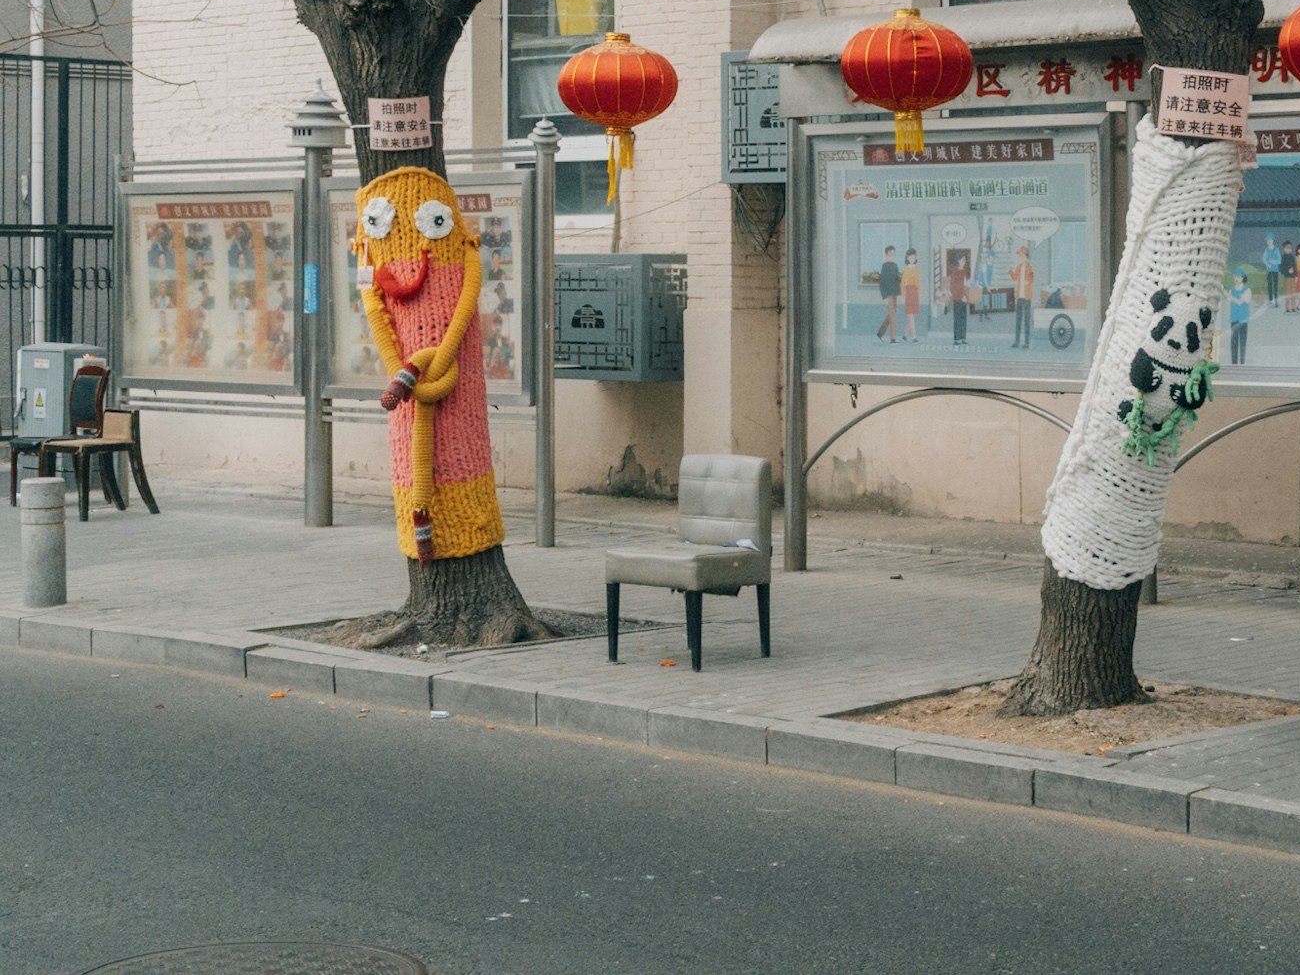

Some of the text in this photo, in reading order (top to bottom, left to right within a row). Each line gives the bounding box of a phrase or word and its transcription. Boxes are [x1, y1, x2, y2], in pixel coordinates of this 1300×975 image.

[1182, 74, 1230, 93] 拍照时
[381, 102, 418, 115] 拍照时
[1165, 95, 1243, 118] 请注意安全
[373, 119, 428, 133] 请注意安全
[1161, 118, 1244, 139] 注意来往车辆
[373, 136, 430, 149] 注意来往车辆
[971, 141, 1044, 161] 建美好家园
[885, 177, 1049, 200] 清理堆物堆料 畅通生命通道
